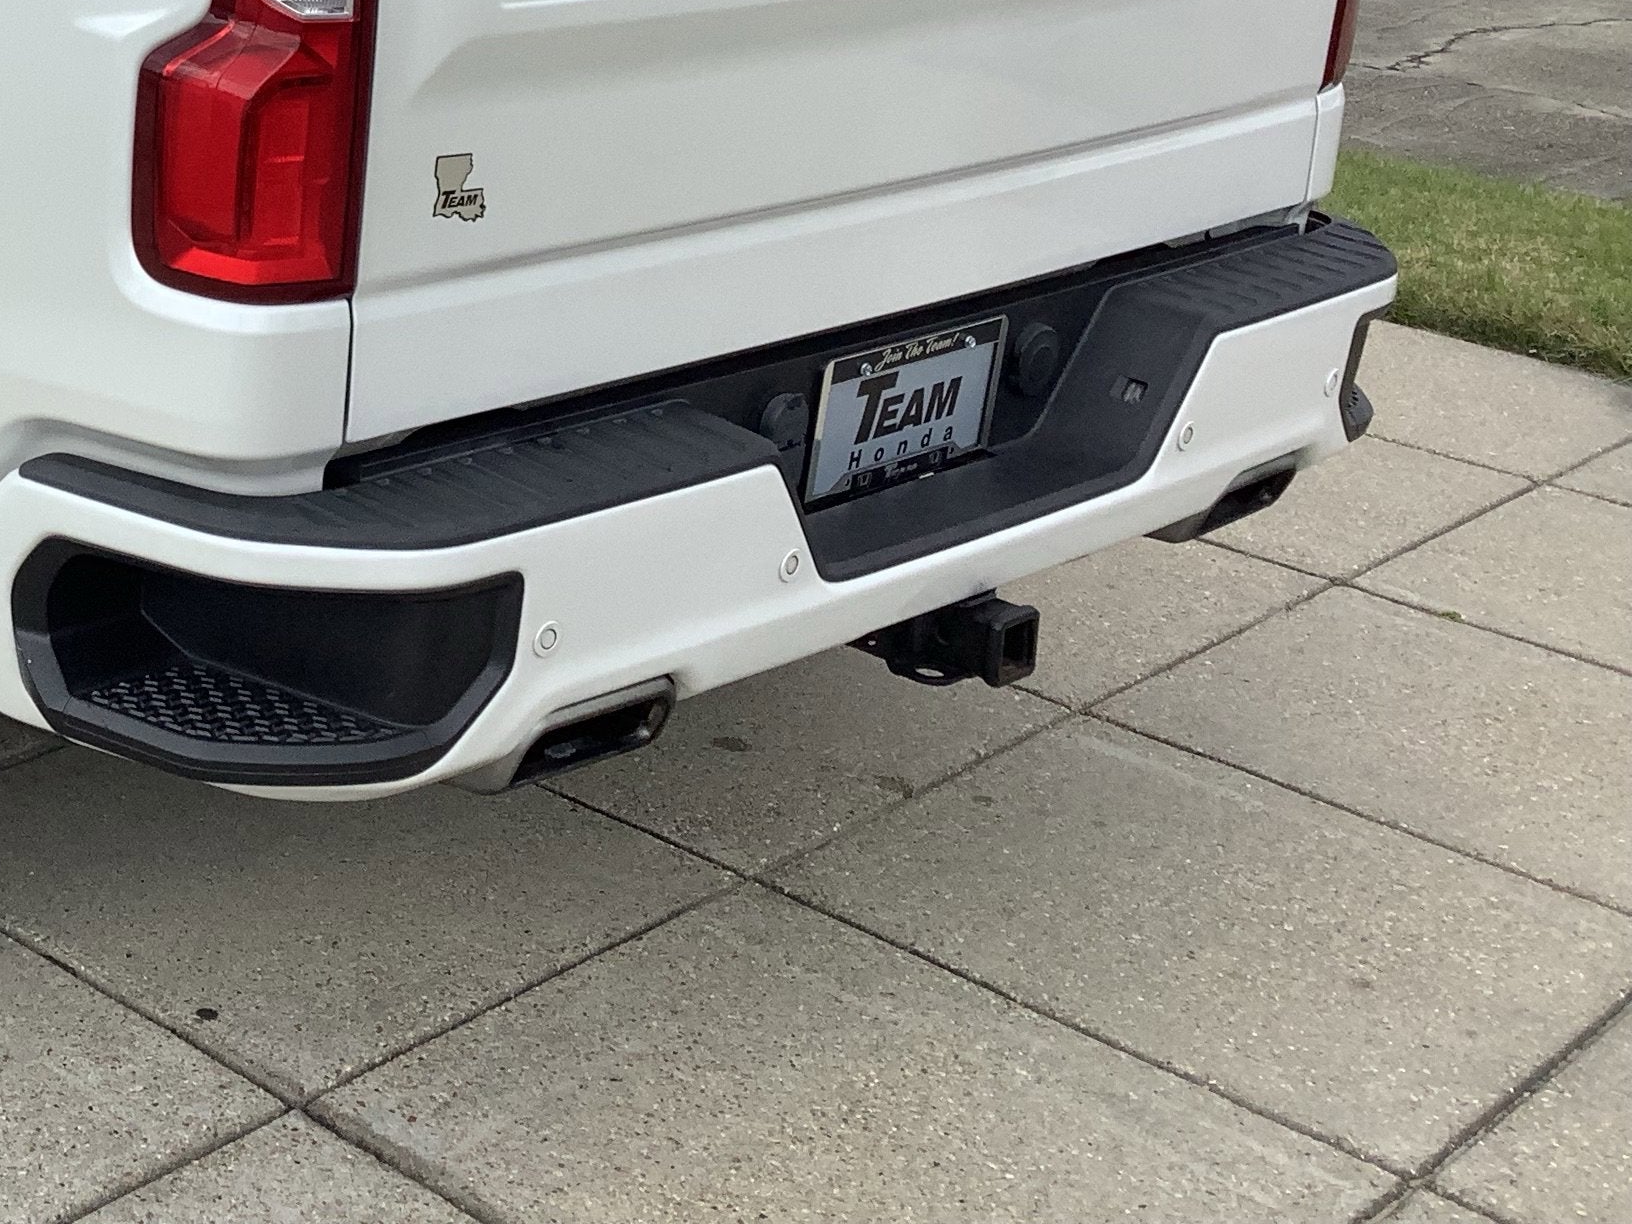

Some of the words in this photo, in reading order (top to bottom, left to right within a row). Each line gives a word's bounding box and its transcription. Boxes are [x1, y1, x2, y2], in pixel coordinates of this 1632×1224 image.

[441, 189, 479, 209] TEAM
[874, 348, 903, 372] Join
[905, 343, 924, 360] The
[926, 332, 960, 355] Team!
[853, 371, 963, 445] TEAM
[848, 426, 953, 470] Honda
